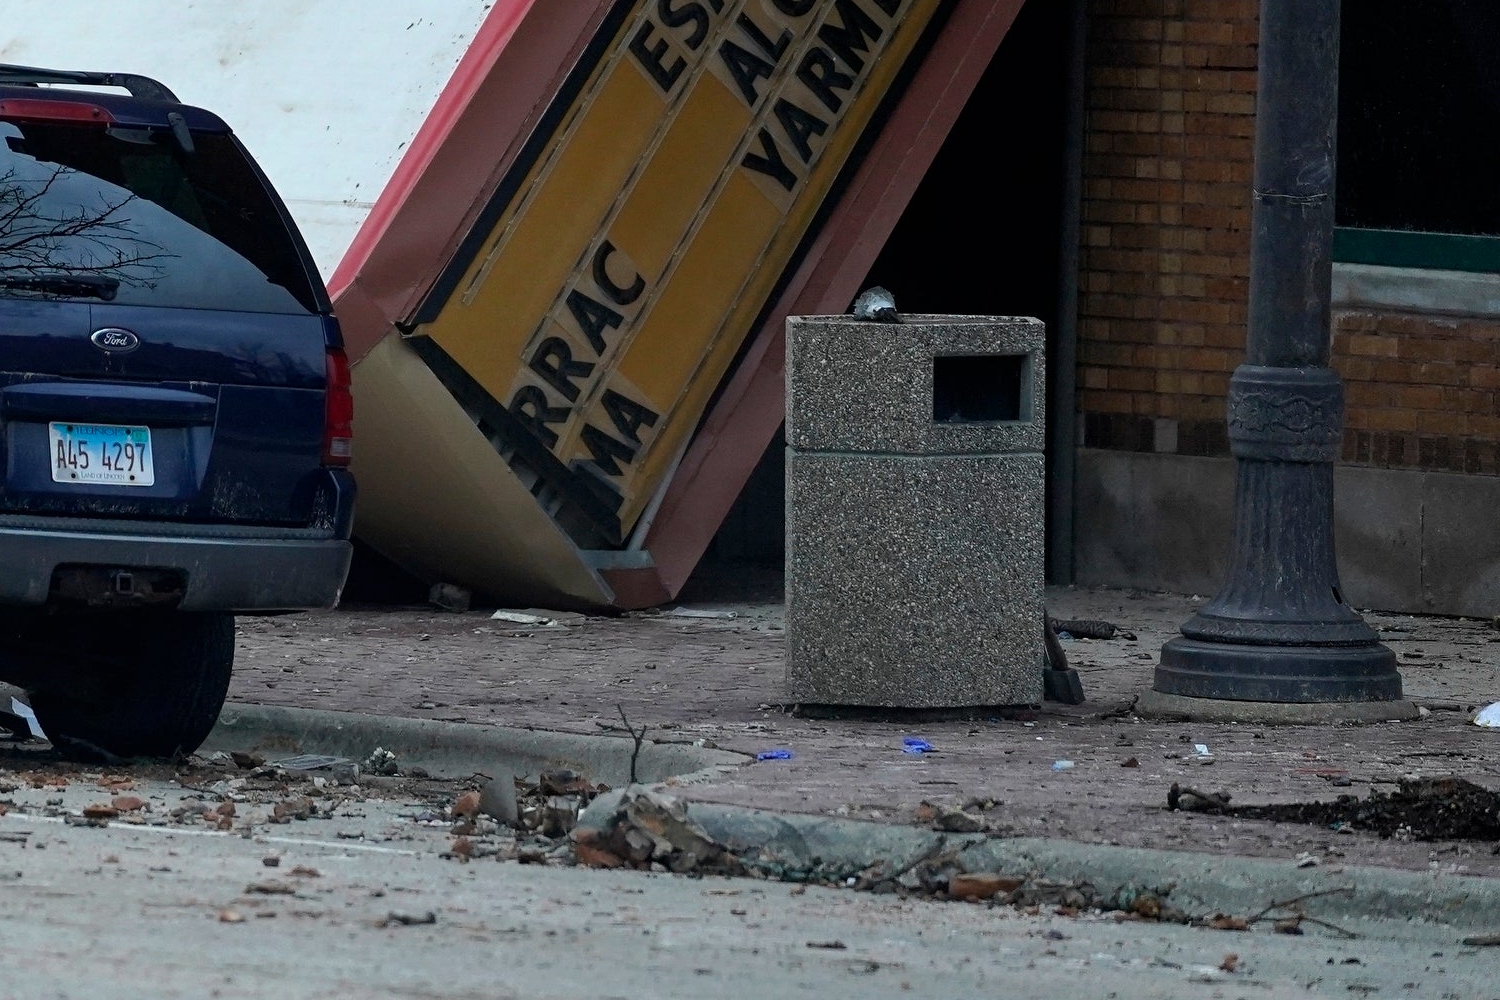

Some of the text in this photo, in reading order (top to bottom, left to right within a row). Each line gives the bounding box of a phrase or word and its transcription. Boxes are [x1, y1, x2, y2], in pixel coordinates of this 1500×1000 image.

[508, 244, 645, 449] RRAC
[57, 439, 147, 473] A45 4297
